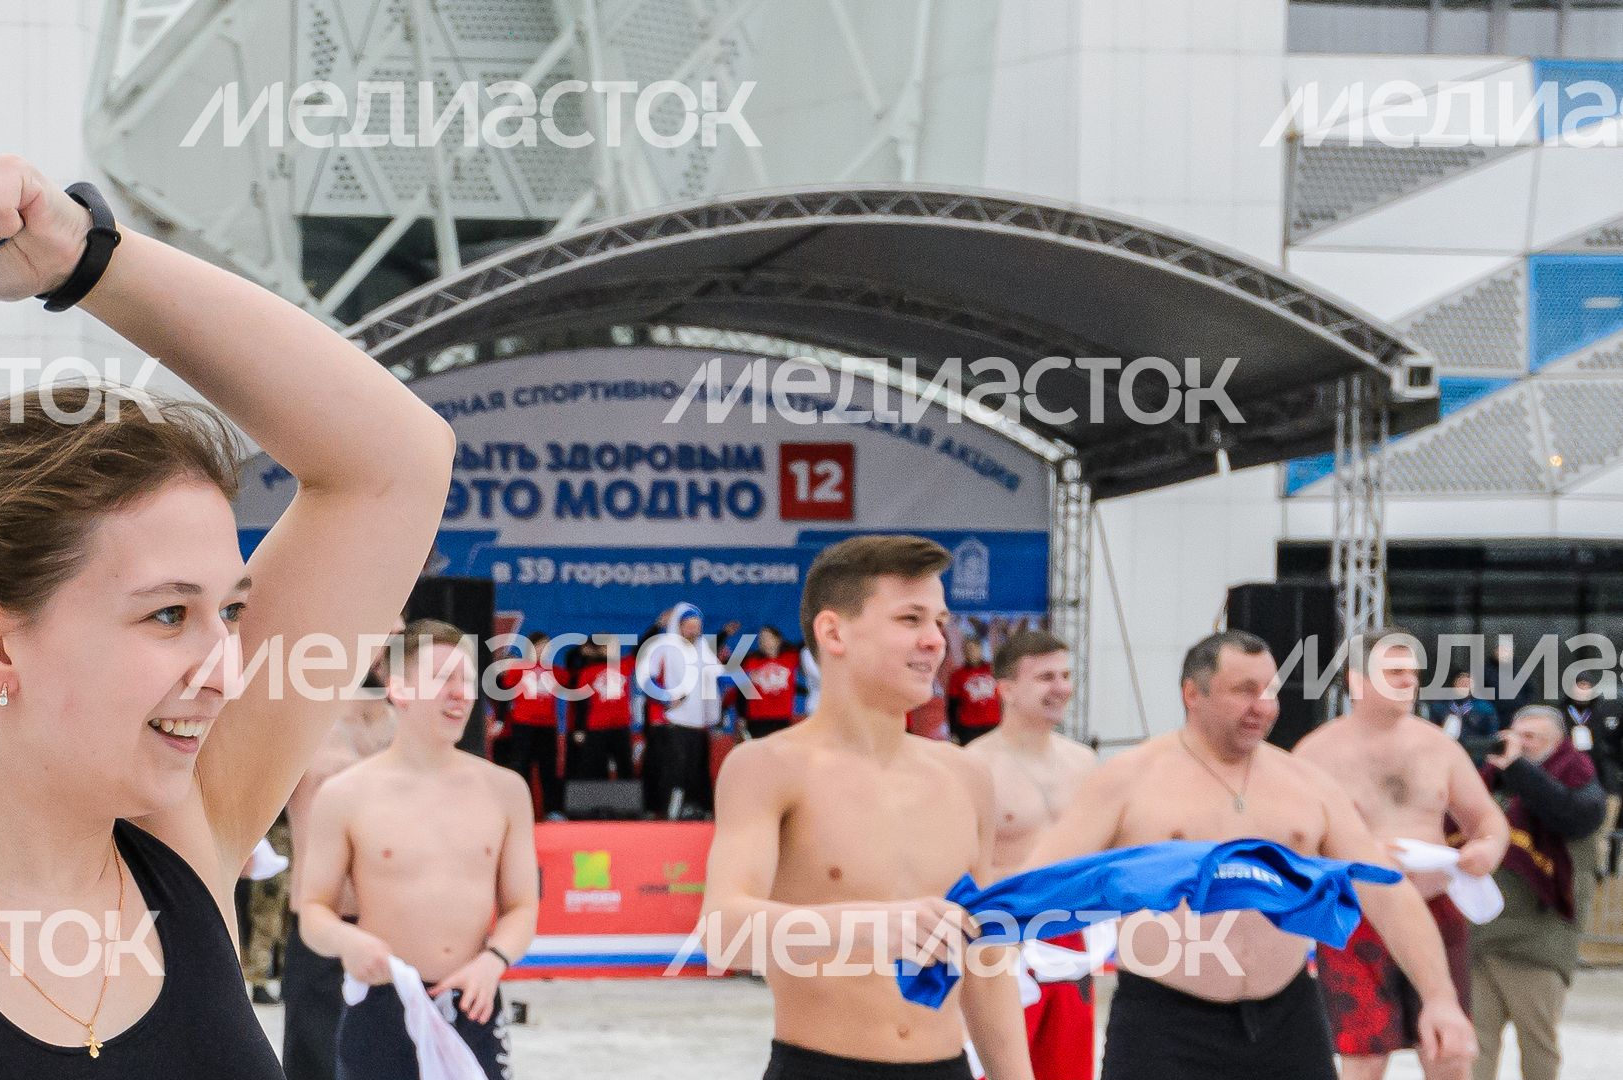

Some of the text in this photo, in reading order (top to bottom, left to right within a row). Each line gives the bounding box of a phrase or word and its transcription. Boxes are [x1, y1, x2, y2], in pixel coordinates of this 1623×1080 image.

[455, 442, 765, 471] ЫТЬ ЗДОРОВЫМ
[442, 478, 765, 520] ЭТО МОДНО
[788, 458, 845, 504] 12
[491, 557, 799, 588] в 39 городах России
